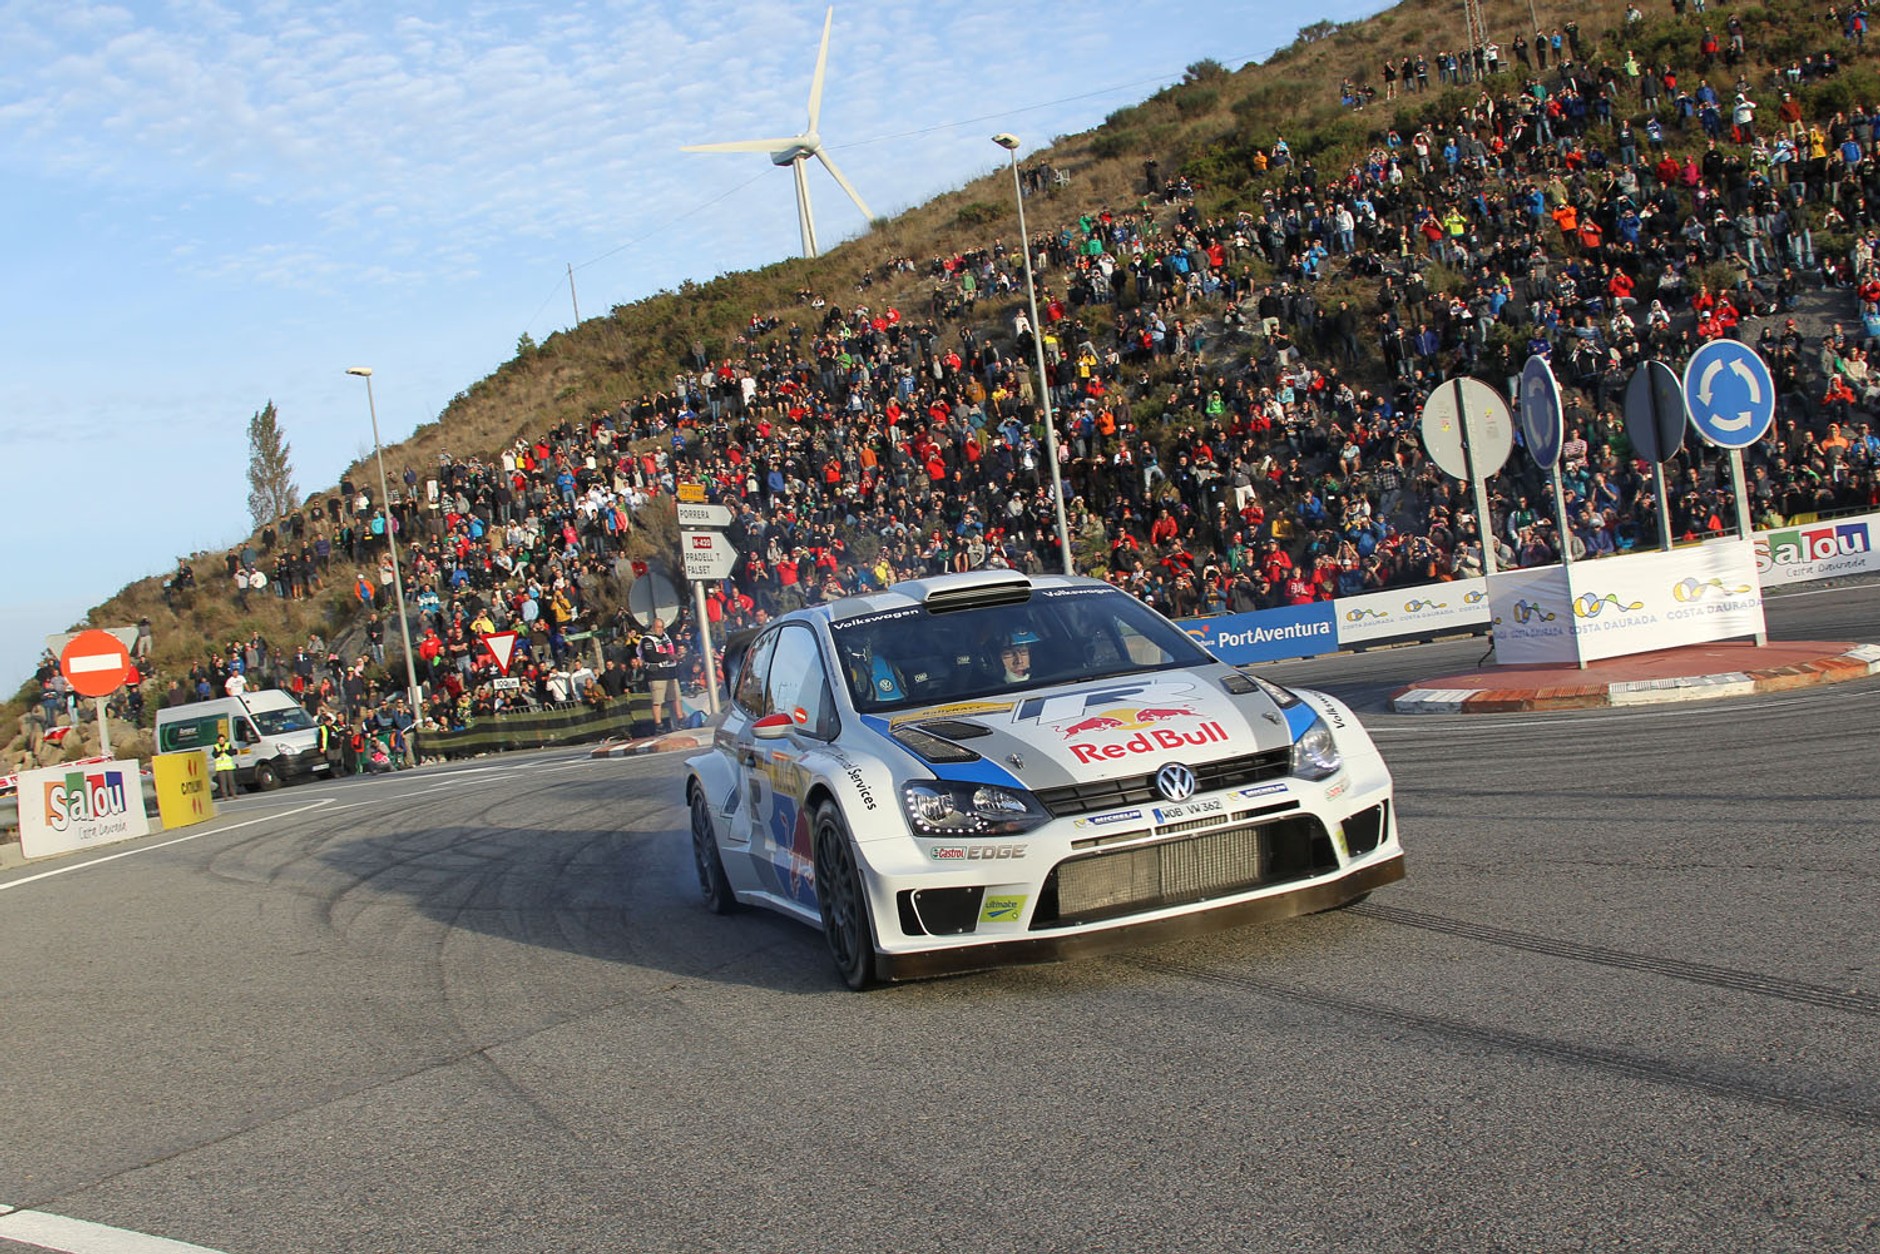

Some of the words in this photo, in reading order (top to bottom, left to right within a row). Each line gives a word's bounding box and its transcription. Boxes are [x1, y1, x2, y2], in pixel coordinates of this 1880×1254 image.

[680, 509, 710, 519] PORRERA
[686, 552, 714, 562] PRADELL
[1753, 532, 1865, 575] Salou
[687, 565, 710, 575] FALSET
[1666, 607, 1705, 620] COSTA
[1706, 598, 1763, 613] DAURADA
[833, 609, 919, 630] Volkswagen
[1569, 623, 1601, 636] COSTA
[1604, 615, 1658, 630] DAURADA
[1218, 621, 1330, 648] PortAventura
[1069, 733, 1153, 764] Red
[1150, 721, 1229, 749] Bull
[847, 768, 877, 811] Services
[1246, 784, 1286, 797] MICHELIN
[50, 780, 124, 832] Salou
[1161, 806, 1184, 818] WOB
[1186, 803, 1201, 815] VW
[1200, 800, 1222, 812] 362
[1094, 811, 1140, 824] MICHELIN
[938, 847, 964, 859] Castrol
[967, 844, 1028, 860] EDGE
[985, 900, 1018, 909] ultimate
